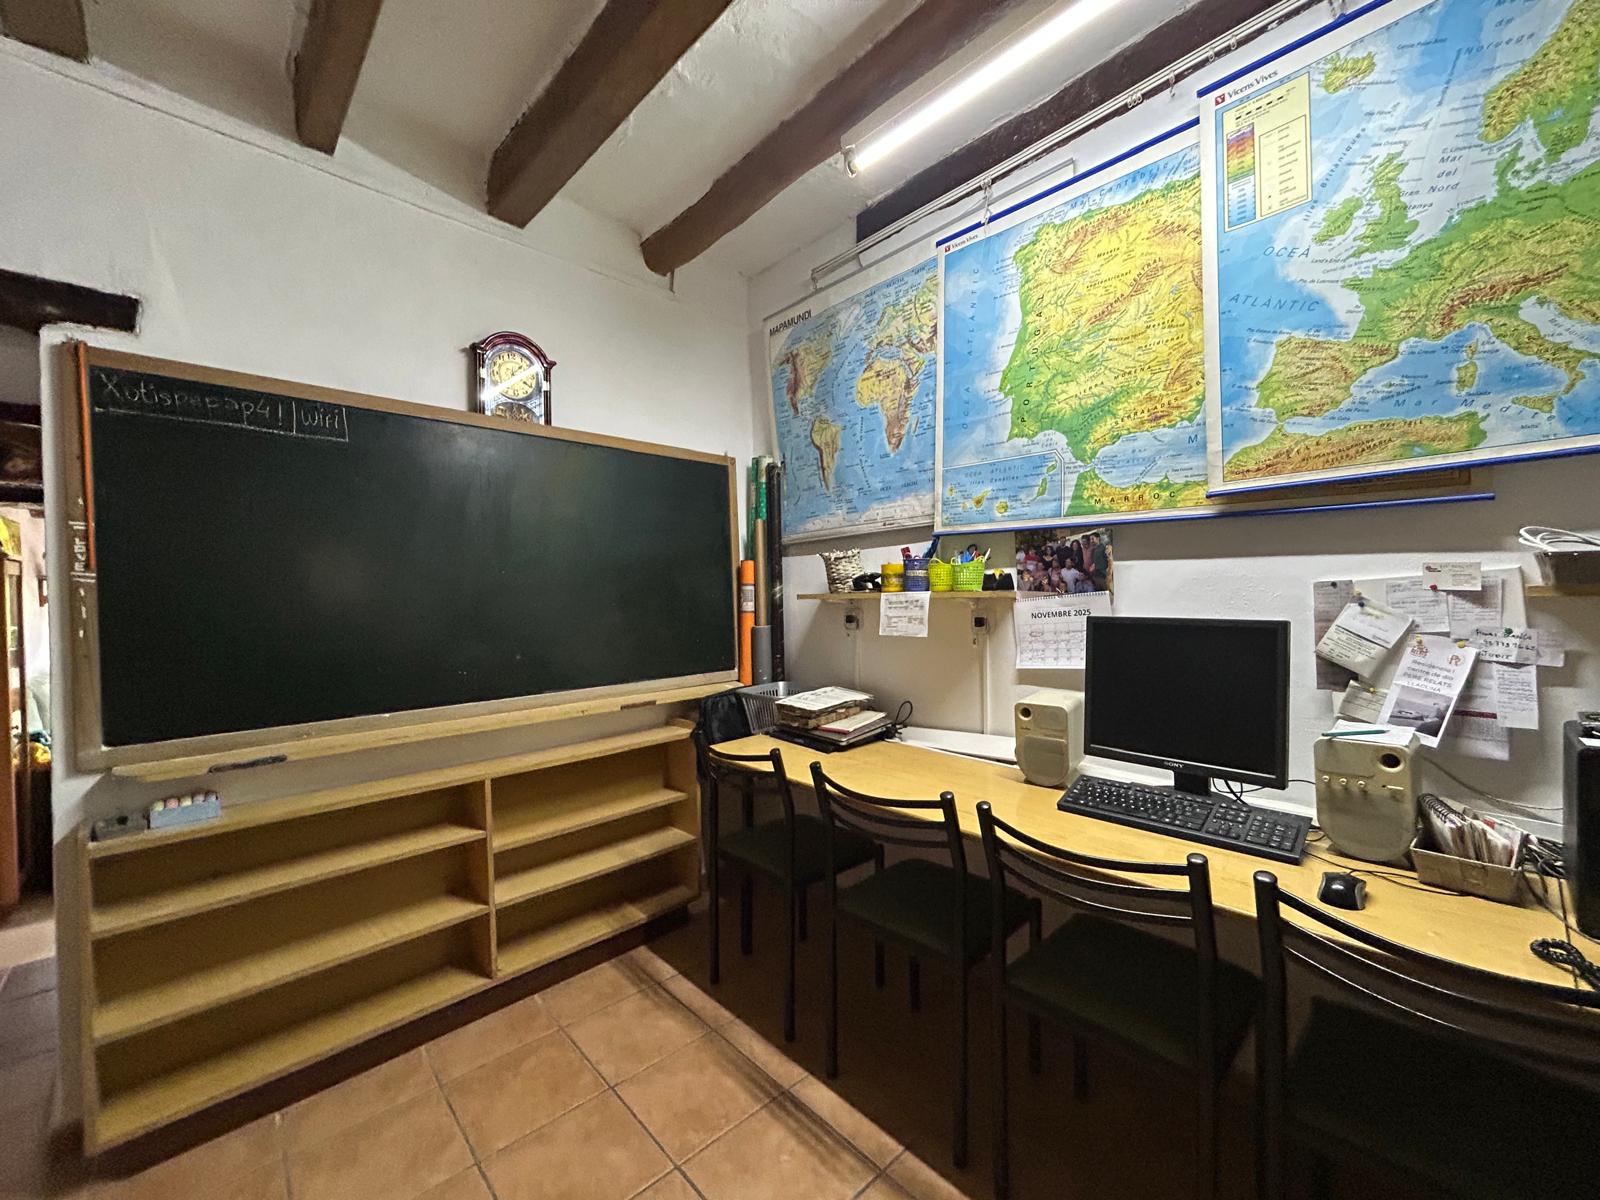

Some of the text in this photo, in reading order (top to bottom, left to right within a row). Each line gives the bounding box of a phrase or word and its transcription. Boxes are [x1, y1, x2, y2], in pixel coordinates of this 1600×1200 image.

[1227, 69, 1279, 99] Vicens Vives
[1439, 154, 1464, 164] Mar
[1436, 168, 1458, 178] del
[1428, 182, 1460, 193] Nord
[1263, 245, 1311, 259] OCEÀ
[1228, 293, 1320, 313] ATLÀNTIC
[769, 308, 812, 337] MAPAMUNDI
[1020, 294, 1045, 424] PORTUGAL
[1393, 398, 1438, 408] Mar
[1114, 398, 1178, 426] SERRALADES
[1094, 491, 1176, 505] MARROC
[1031, 608, 1092, 619] NOVEMBRE 2025
